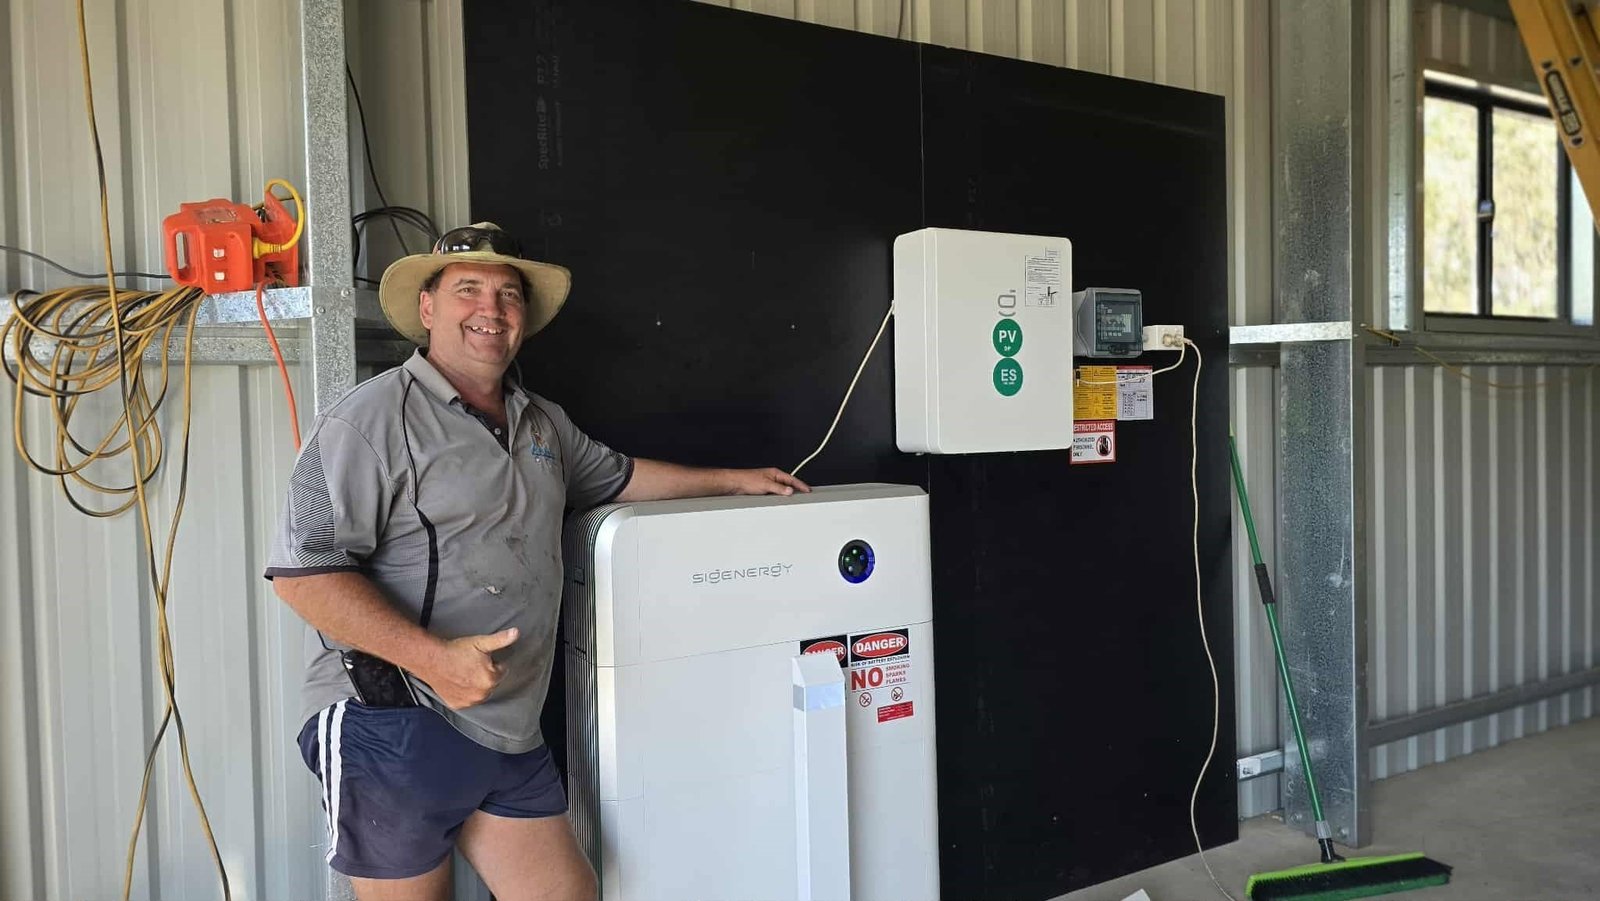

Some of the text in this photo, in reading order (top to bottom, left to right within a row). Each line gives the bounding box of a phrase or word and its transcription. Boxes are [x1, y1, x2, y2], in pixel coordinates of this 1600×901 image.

[999, 330, 1017, 343] PV
[1001, 369, 1017, 382] ES
[1073, 422, 1114, 432] ESTRICTED ACCESS
[856, 637, 904, 653] DANGER
[851, 667, 884, 690] NO
